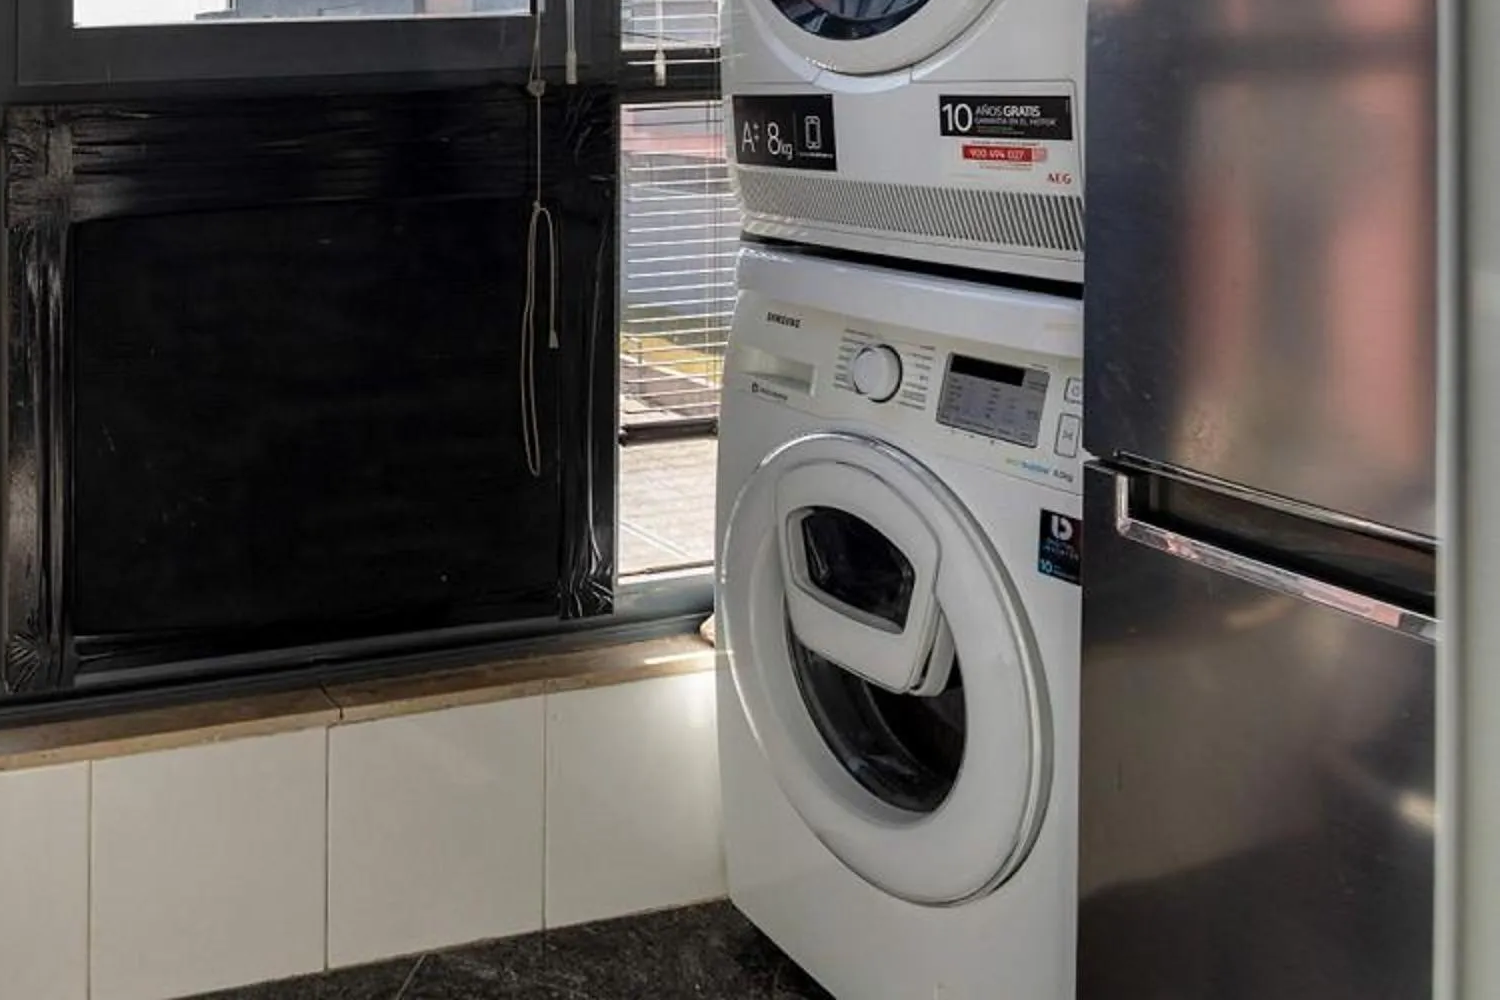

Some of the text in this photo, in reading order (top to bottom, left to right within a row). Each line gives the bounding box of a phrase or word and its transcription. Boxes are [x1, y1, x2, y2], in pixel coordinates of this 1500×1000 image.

[941, 102, 973, 132] 10
[974, 103, 1002, 117] AÑOS
[1003, 104, 1041, 118] GRATIS
[1047, 173, 1072, 185] AEG
